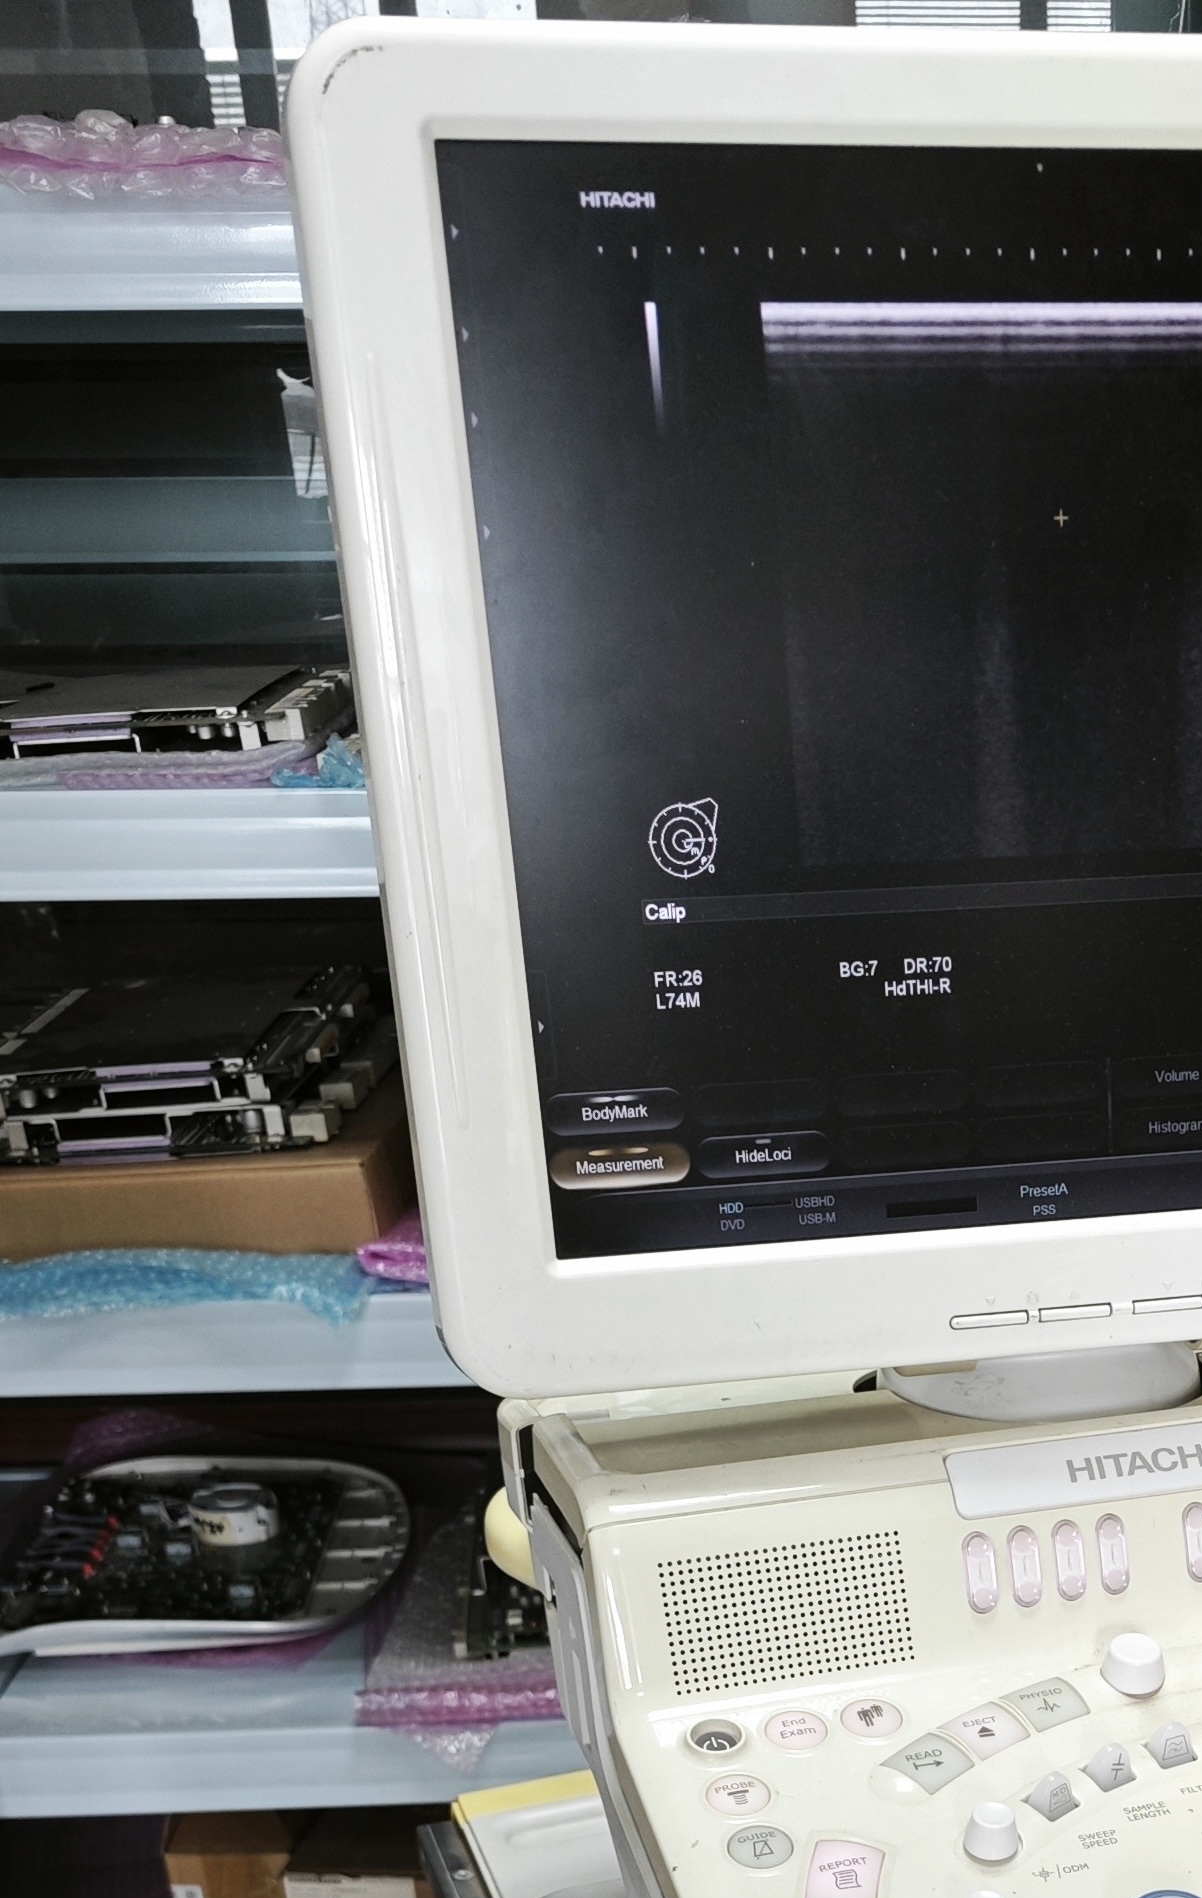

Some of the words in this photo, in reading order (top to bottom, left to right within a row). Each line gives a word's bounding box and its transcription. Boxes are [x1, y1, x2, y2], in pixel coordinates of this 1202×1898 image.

[580, 190, 656, 210] HITACHI
[645, 904, 686, 922] Calip
[839, 961, 877, 979] BG:7
[904, 956, 952, 974] DR:70
[654, 970, 703, 988] FR:26
[884, 978, 951, 997] HdTHI-R
[656, 991, 701, 1009] L74M
[1154, 1068, 1200, 1083] Volume
[582, 1103, 648, 1122] BodyMark
[735, 1147, 792, 1164] HideLoci
[575, 1156, 664, 1176] Measurement
[1020, 1183, 1068, 1198] PresetA
[719, 1201, 744, 1215] HDD
[794, 1194, 835, 1209] USBHD
[1033, 1203, 1056, 1216] PSS
[720, 1218, 745, 1231] DVD
[799, 1211, 836, 1225] USB-M
[1019, 1687, 1062, 1701] PHYSIO
[782, 1717, 806, 1728] End
[962, 1715, 996, 1729] EJECT
[779, 1725, 816, 1738] Exam
[905, 1748, 942, 1763] READ
[714, 1779, 756, 1793] PROBE
[1122, 1801, 1167, 1816] SAMPLE
[1127, 1807, 1172, 1823] LENGTH
[737, 1830, 776, 1844] GUIDE
[1078, 1829, 1116, 1843] SWEEP
[1081, 1835, 1118, 1850] SPEED
[818, 1856, 867, 1873] REPORT
[1062, 1862, 1090, 1875] ODM
